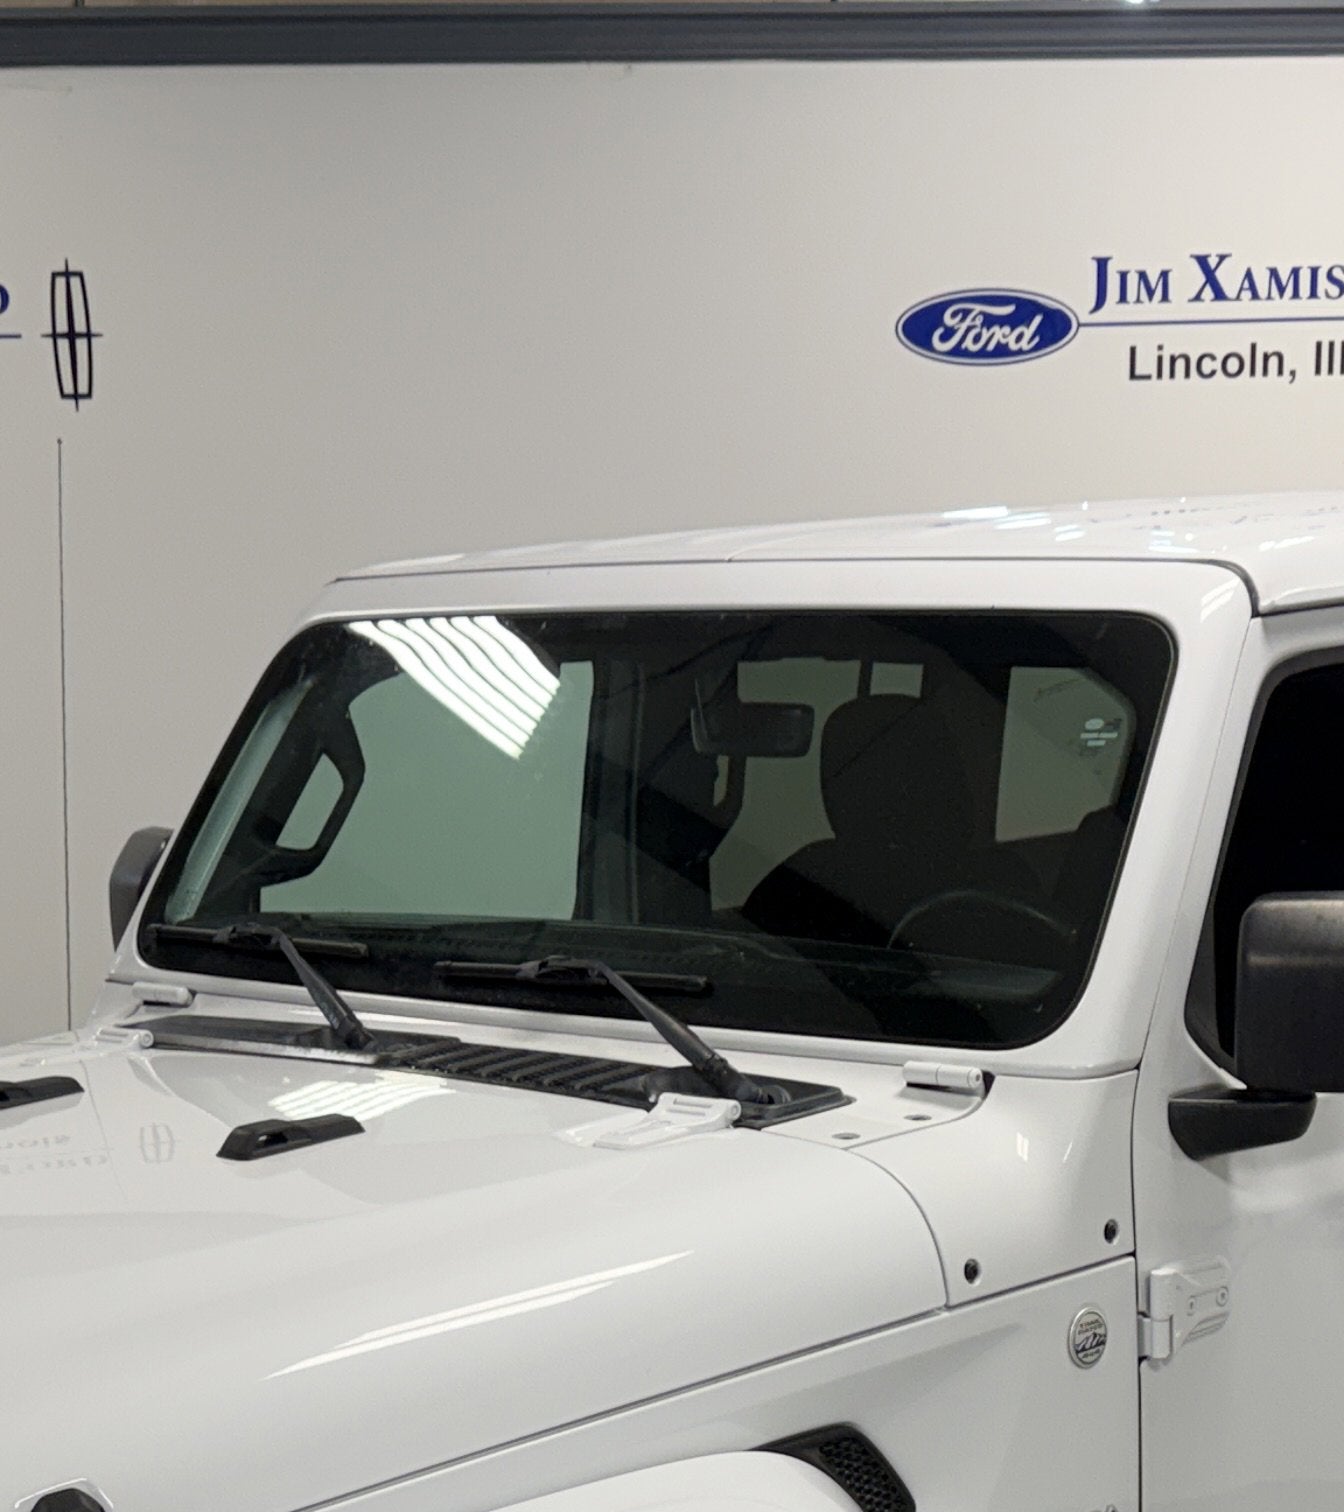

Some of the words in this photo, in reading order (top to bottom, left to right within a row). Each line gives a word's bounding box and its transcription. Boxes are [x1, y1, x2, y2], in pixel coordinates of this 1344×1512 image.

[1088, 256, 1172, 315] JIM
[931, 303, 1041, 354] Ford
[1128, 342, 1297, 383] Lincoln,
